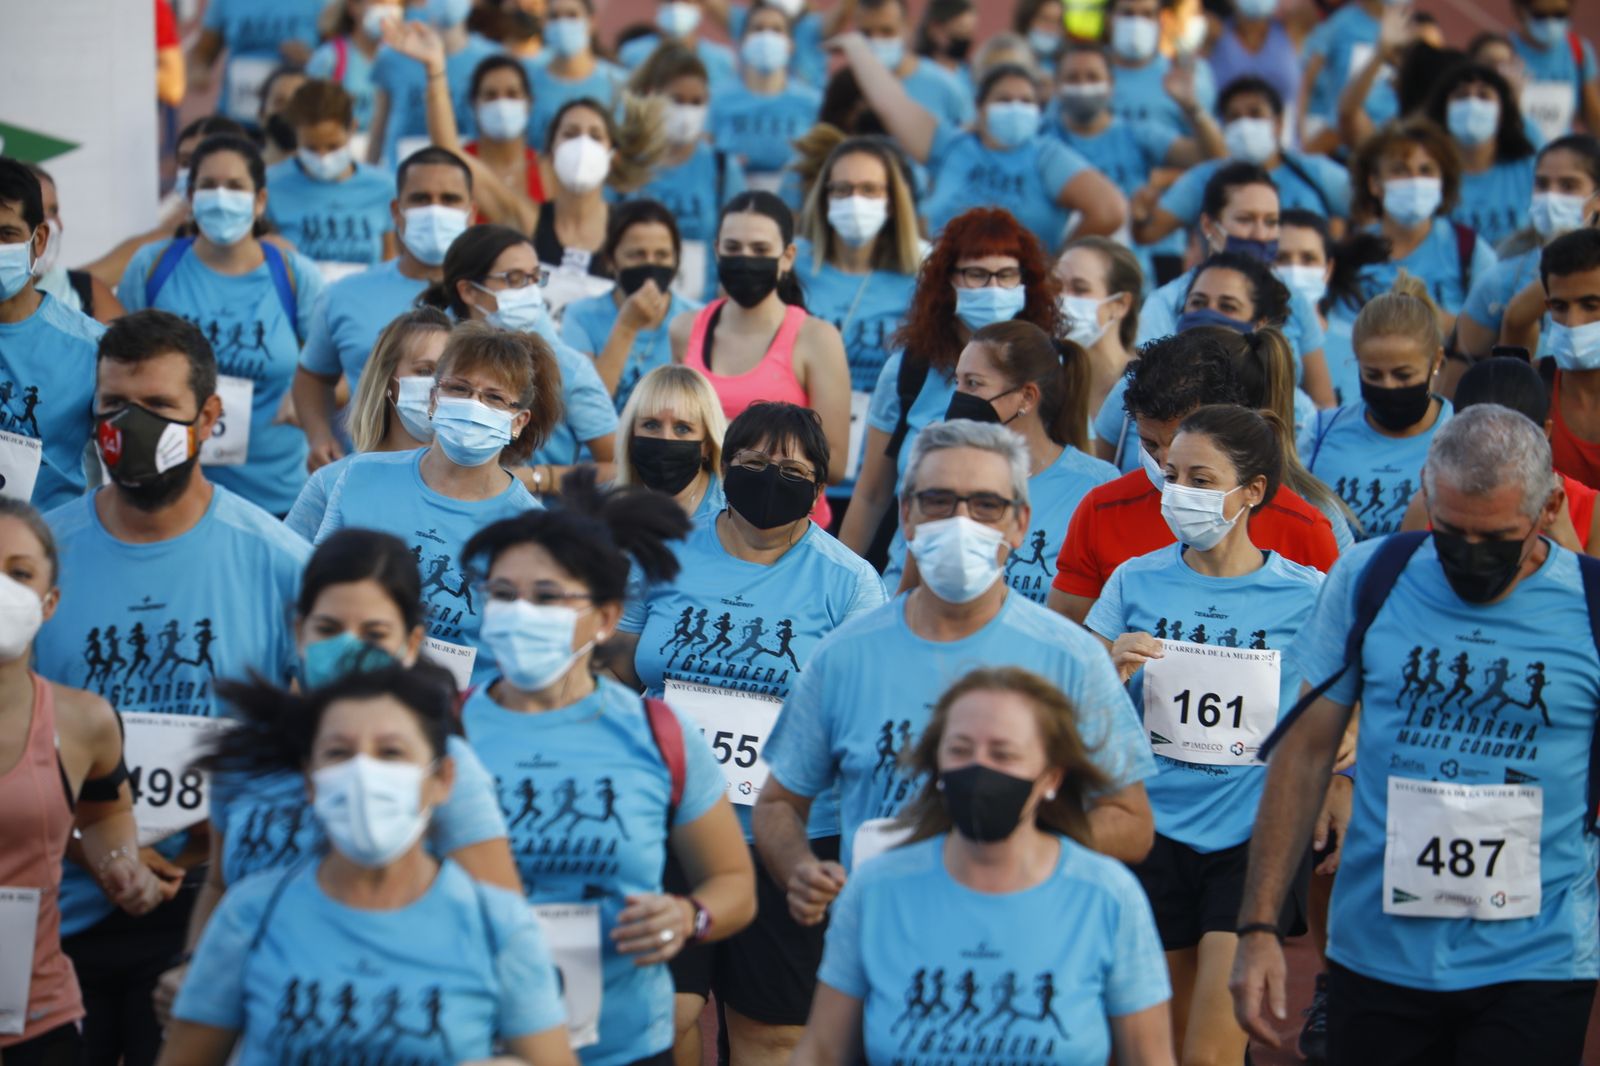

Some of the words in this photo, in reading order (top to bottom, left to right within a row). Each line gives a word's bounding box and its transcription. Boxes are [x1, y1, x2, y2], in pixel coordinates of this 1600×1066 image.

[1168, 643, 1205, 655] CARRERA
[1208, 649, 1217, 657] DE
[1233, 652, 1259, 660] MUJER
[687, 684, 722, 696] CARRERA
[724, 688, 733, 696] DE
[735, 690, 746, 699] LA
[1174, 689, 1243, 728] 161
[700, 728, 760, 768] 55
[1396, 729, 1451, 750] MUJER
[128, 766, 203, 810] 498
[1416, 835, 1506, 878] 487
